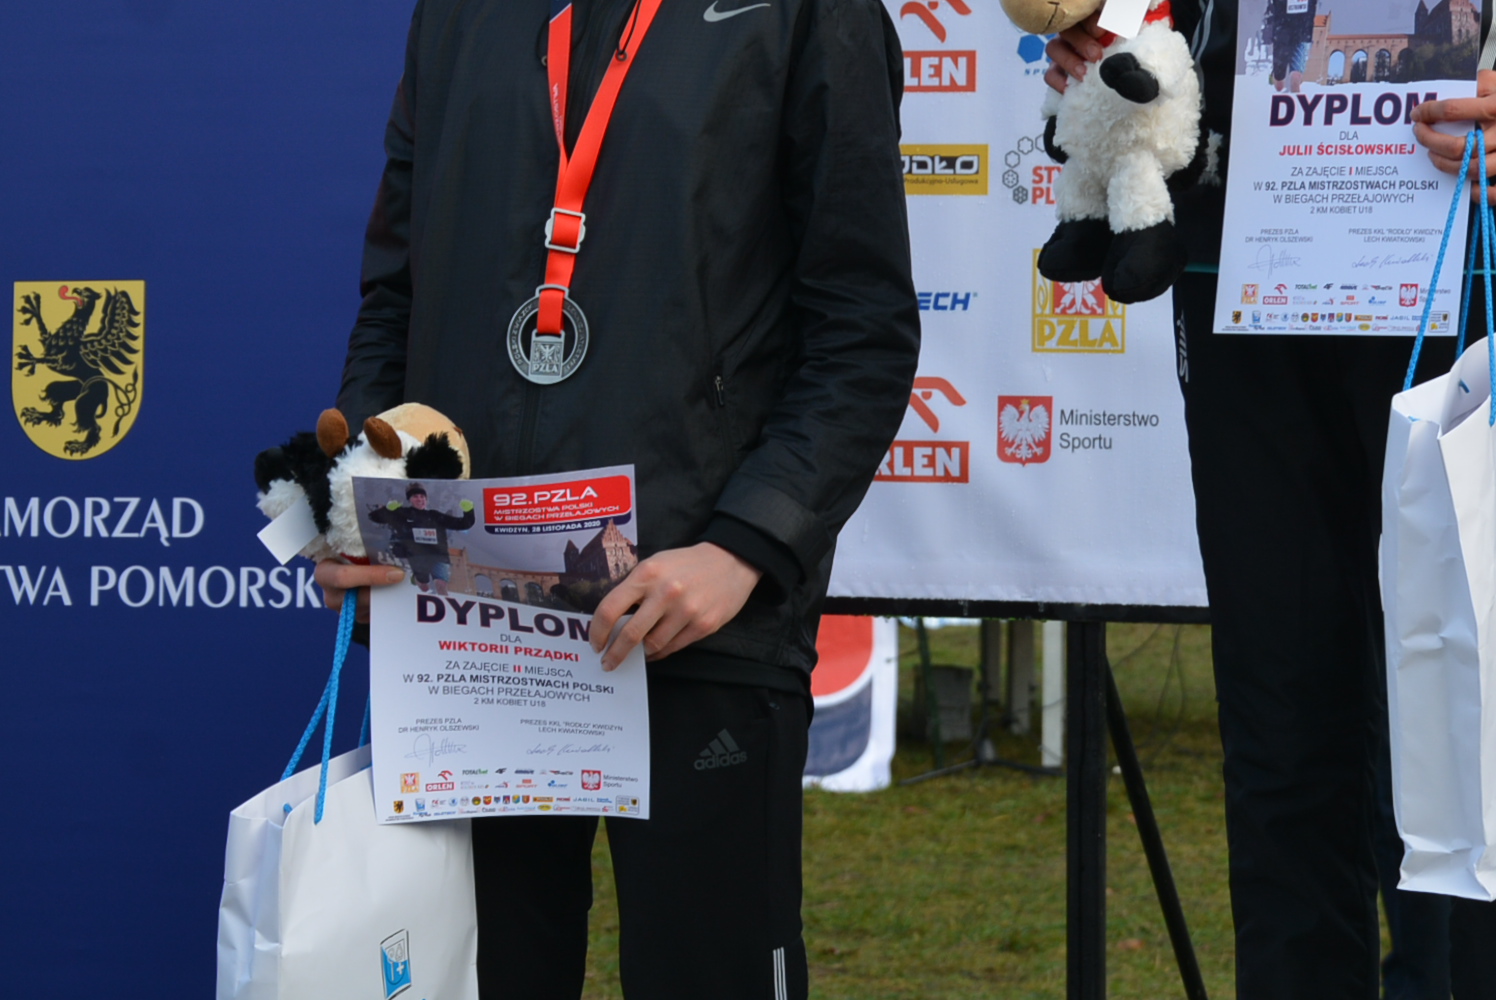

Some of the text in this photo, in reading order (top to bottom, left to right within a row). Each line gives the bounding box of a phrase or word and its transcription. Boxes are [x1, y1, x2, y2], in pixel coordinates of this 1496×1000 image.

[903, 55, 968, 88] LEN
[1339, 131, 1359, 141] DLA
[1279, 142, 1417, 157] JULII ŚCISŁOWSKIEJ
[901, 154, 980, 176] DŁO
[1355, 166, 1399, 176] MIEJSCA
[1265, 181, 1279, 191] 92.
[1281, 181, 1306, 190] PZLA
[1308, 180, 1396, 190] MISTRZOSTWACH
[1399, 180, 1439, 190] POLSKI
[1284, 194, 1329, 204] BIEGACH
[1036, 319, 1120, 348] PZLA
[1059, 408, 1160, 427] Ministerstwo
[1059, 432, 1113, 453] Sportu
[874, 445, 961, 478] LEN
[493, 485, 599, 507] 92.PZLA
[0, 496, 205, 547] MORZĄD
[90, 565, 322, 610] POMORSK
[500, 633, 522, 644] DLA
[438, 640, 581, 662] WIKTORII PRZĄDKI
[524, 665, 573, 678] MIEJSCA
[416, 673, 434, 683] 92.
[436, 674, 467, 683] PZLA
[469, 674, 570, 690] MISTRZOSTWACH
[572, 682, 614, 695] POLSKI
[442, 685, 494, 696] BIEGACH
[694, 751, 748, 770] adidas
